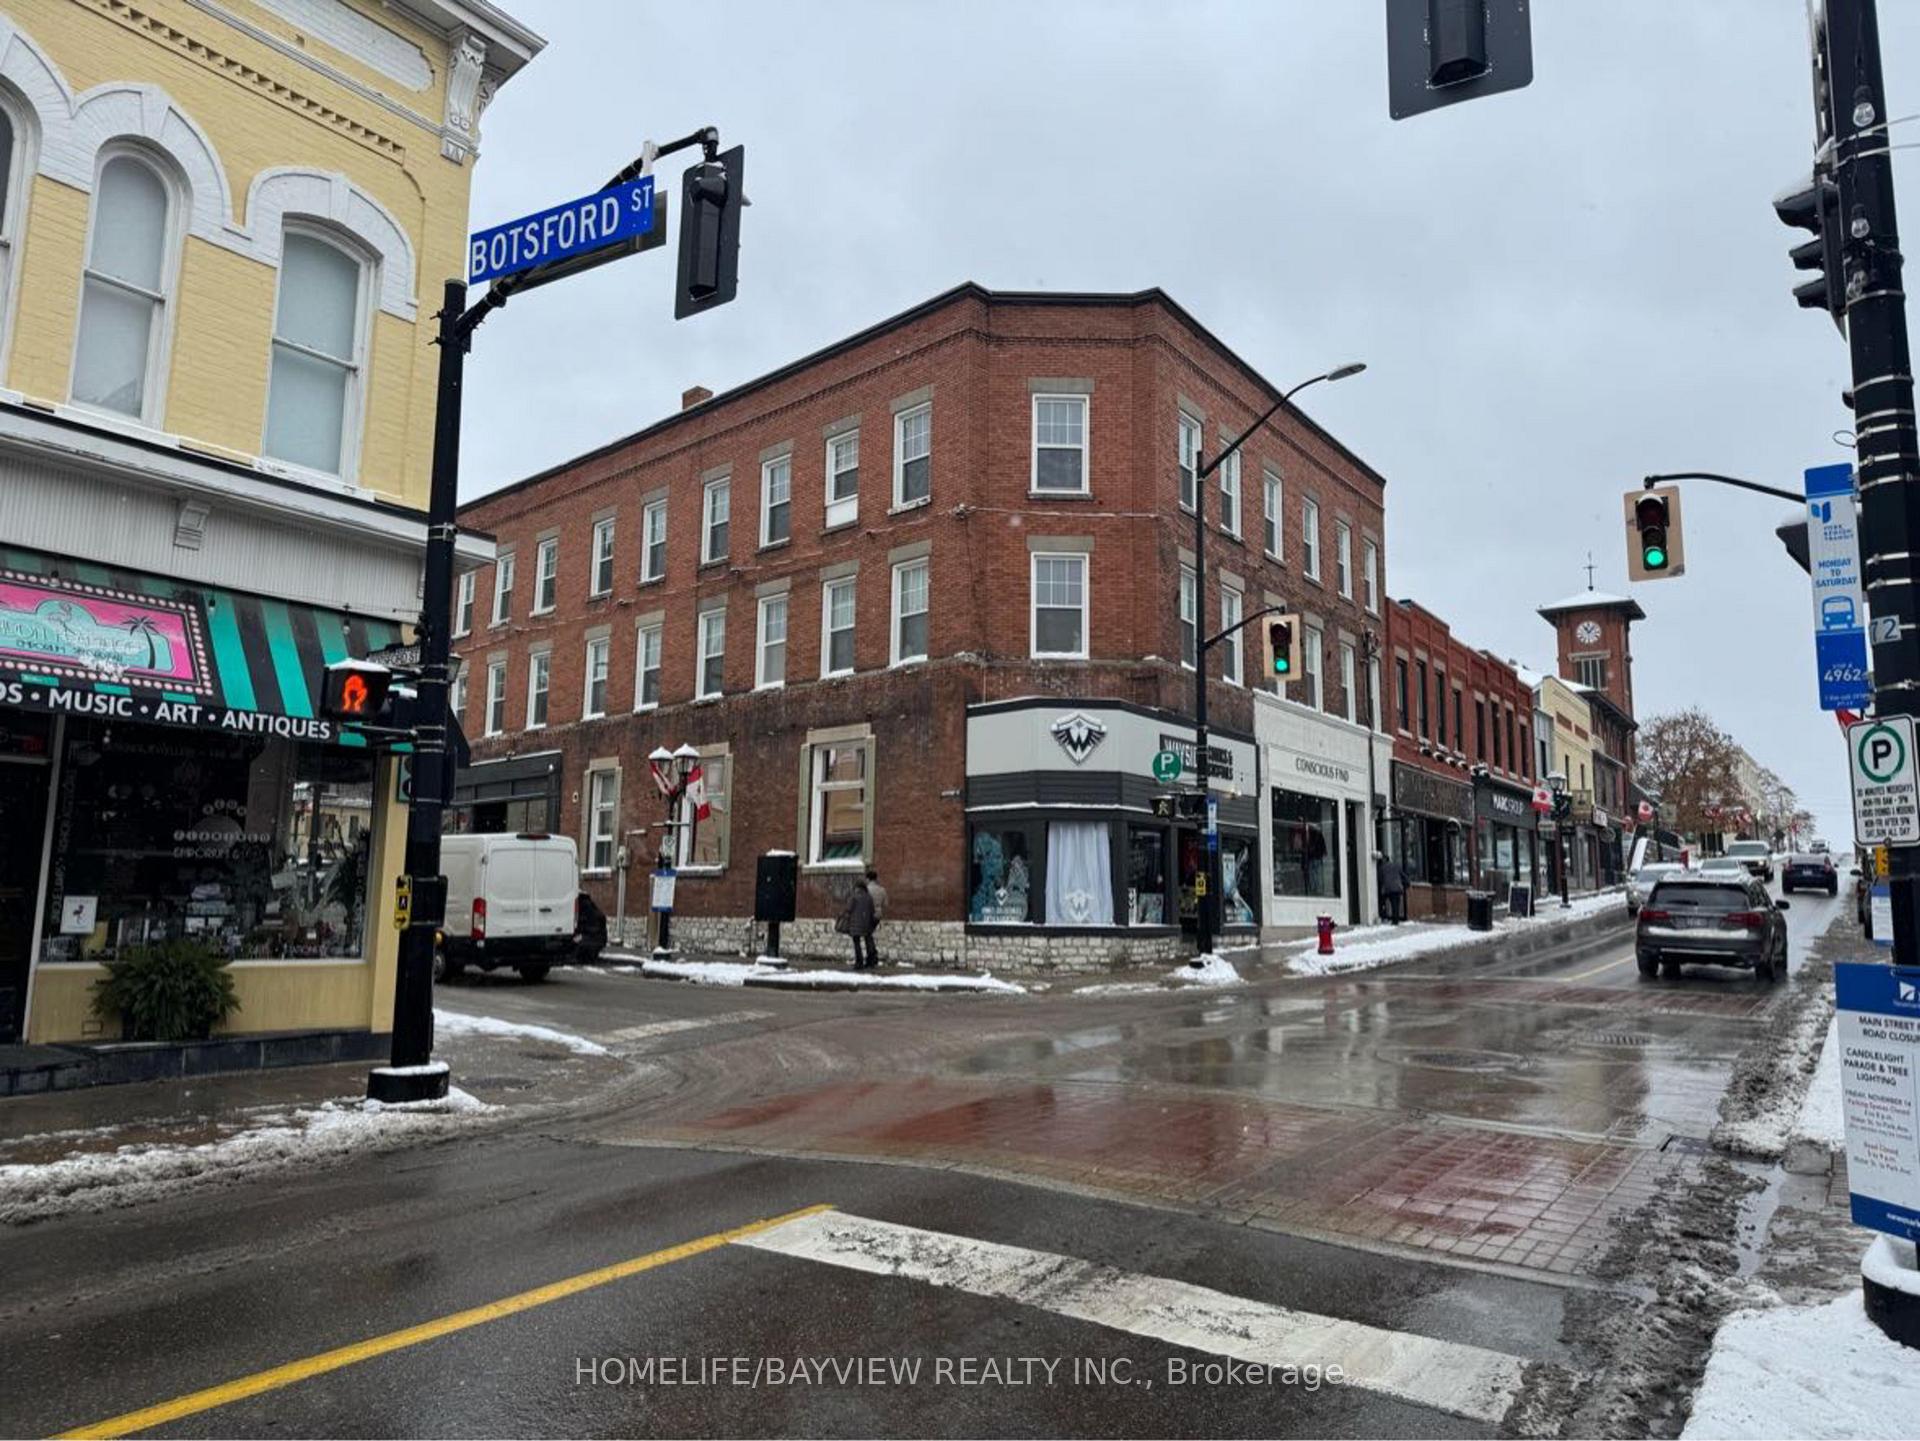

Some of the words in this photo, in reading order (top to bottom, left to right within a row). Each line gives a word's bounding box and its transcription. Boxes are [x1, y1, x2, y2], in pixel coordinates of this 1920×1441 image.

[471, 196, 619, 278] BOTSFORD
[631, 185, 652, 212] ST
[1818, 559, 1852, 568] MONDAY
[1815, 577, 1857, 588] SATURDAY
[1824, 669, 1861, 682] 4962
[48, 688, 133, 717] MUSIC
[154, 702, 203, 725] ART
[221, 711, 331, 740] ANTIQUES
[1161, 753, 1174, 771] P
[1872, 739, 1892, 770] P
[1295, 757, 1334, 779] CONSCIOUS
[1335, 767, 1350, 783] FIND
[1859, 1016, 1882, 1027] MAIN
[1884, 1019, 1914, 1031] STREET
[1862, 1028, 1887, 1039] ROAD
[1846, 1047, 1904, 1064] CANDLELIGHT
[1843, 1059, 1876, 1072] PARADE
[1879, 1064, 1885, 1073] &
[1888, 1065, 1908, 1077] TREE
[1856, 1072, 1896, 1086] LIGHTING
[1867, 1091, 1902, 1105] NOVEMBER
